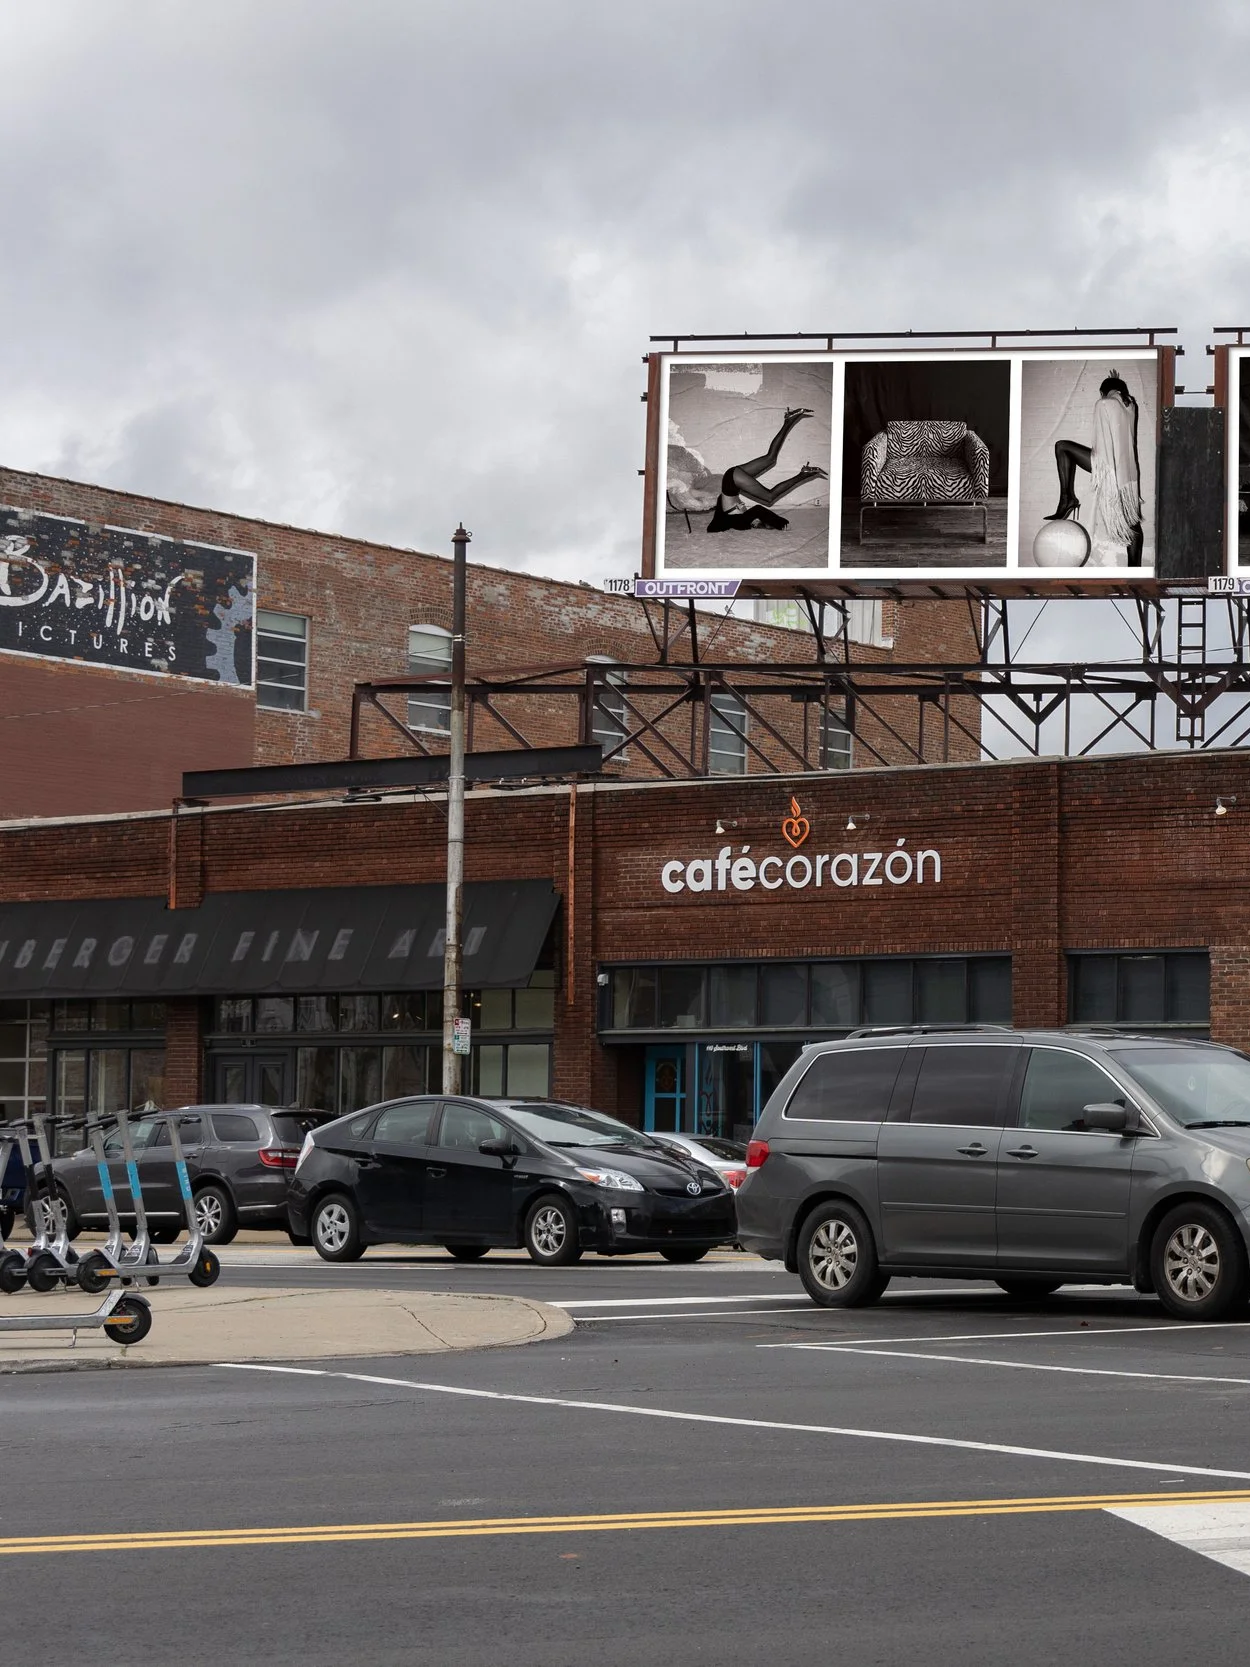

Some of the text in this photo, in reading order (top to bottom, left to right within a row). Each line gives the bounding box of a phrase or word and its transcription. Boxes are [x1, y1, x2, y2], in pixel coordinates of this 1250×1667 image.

[608, 579, 630, 592] 1178
[644, 581, 730, 595] OUTFRONT
[1212, 577, 1235, 590] 1179
[231, 928, 355, 963] FINE
